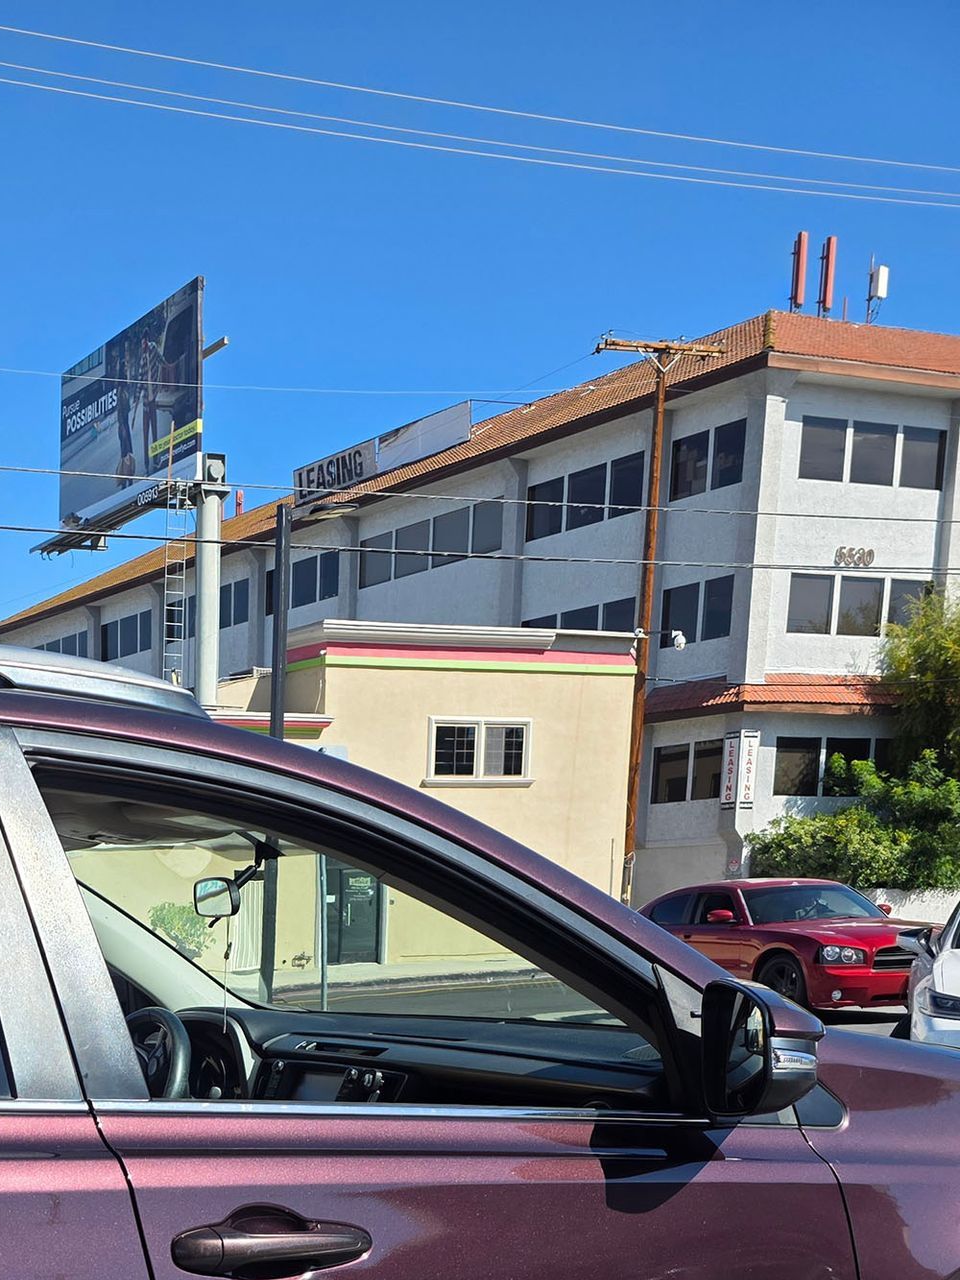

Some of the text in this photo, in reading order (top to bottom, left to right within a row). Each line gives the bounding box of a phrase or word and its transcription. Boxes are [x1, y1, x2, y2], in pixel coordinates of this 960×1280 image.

[66, 388, 118, 436] POSSIBILITIES
[298, 450, 364, 500] LEASING
[724, 741, 735, 801] LEASING
[743, 740, 753, 801] LEASING
